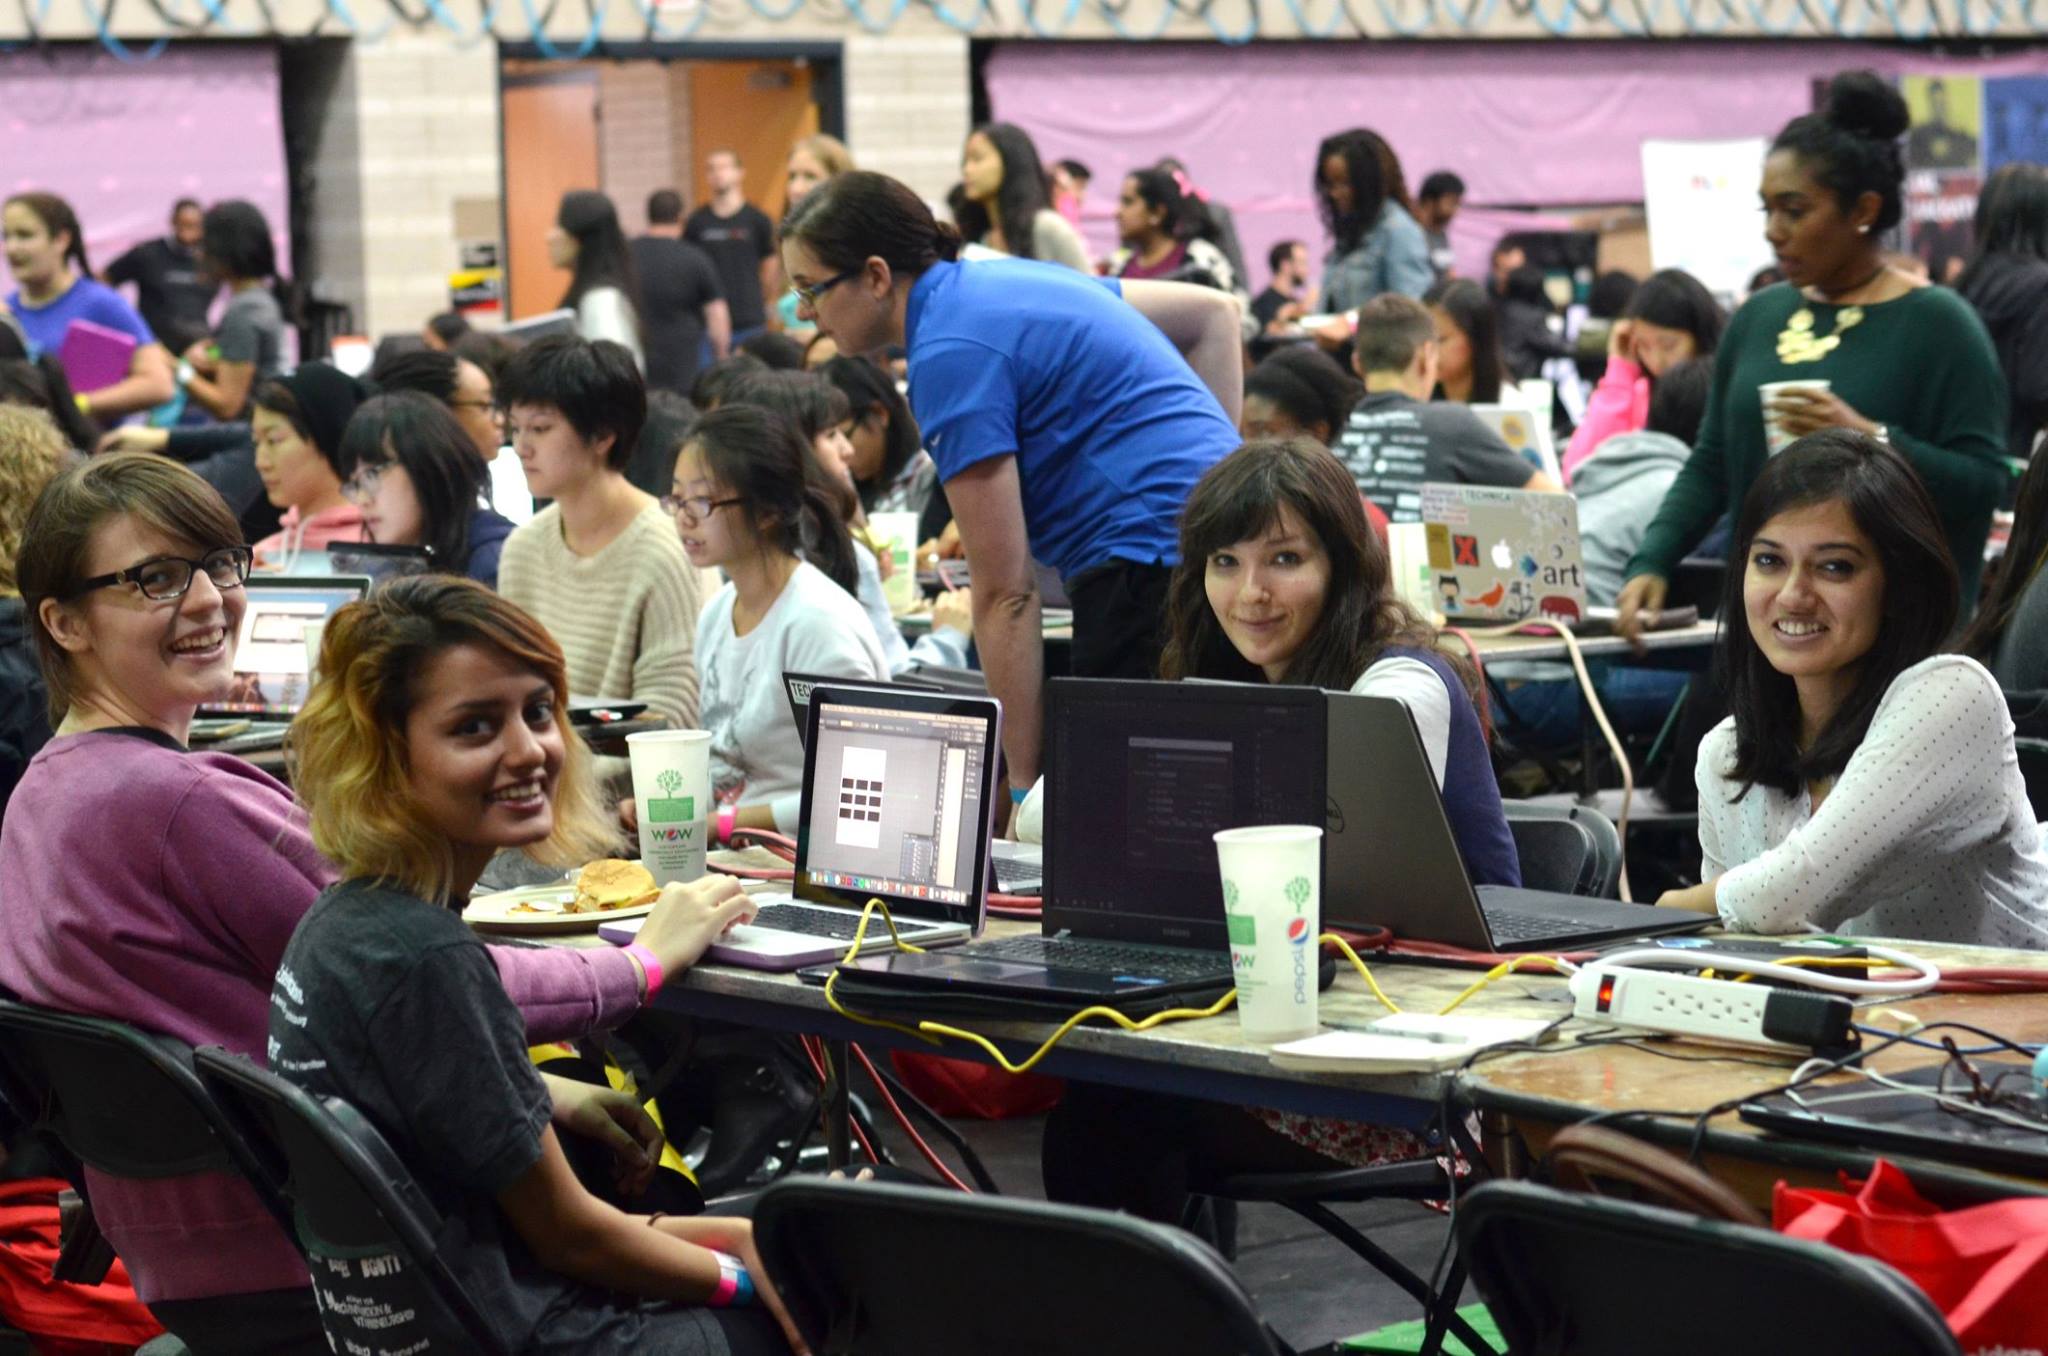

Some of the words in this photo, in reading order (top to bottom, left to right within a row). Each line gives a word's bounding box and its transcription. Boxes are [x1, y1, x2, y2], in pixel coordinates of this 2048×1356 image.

[1465, 489, 1511, 501] TECHNICA
[1543, 563, 1580, 587] art
[651, 827, 693, 841] WOW
[1292, 947, 1307, 1004] pepsi
